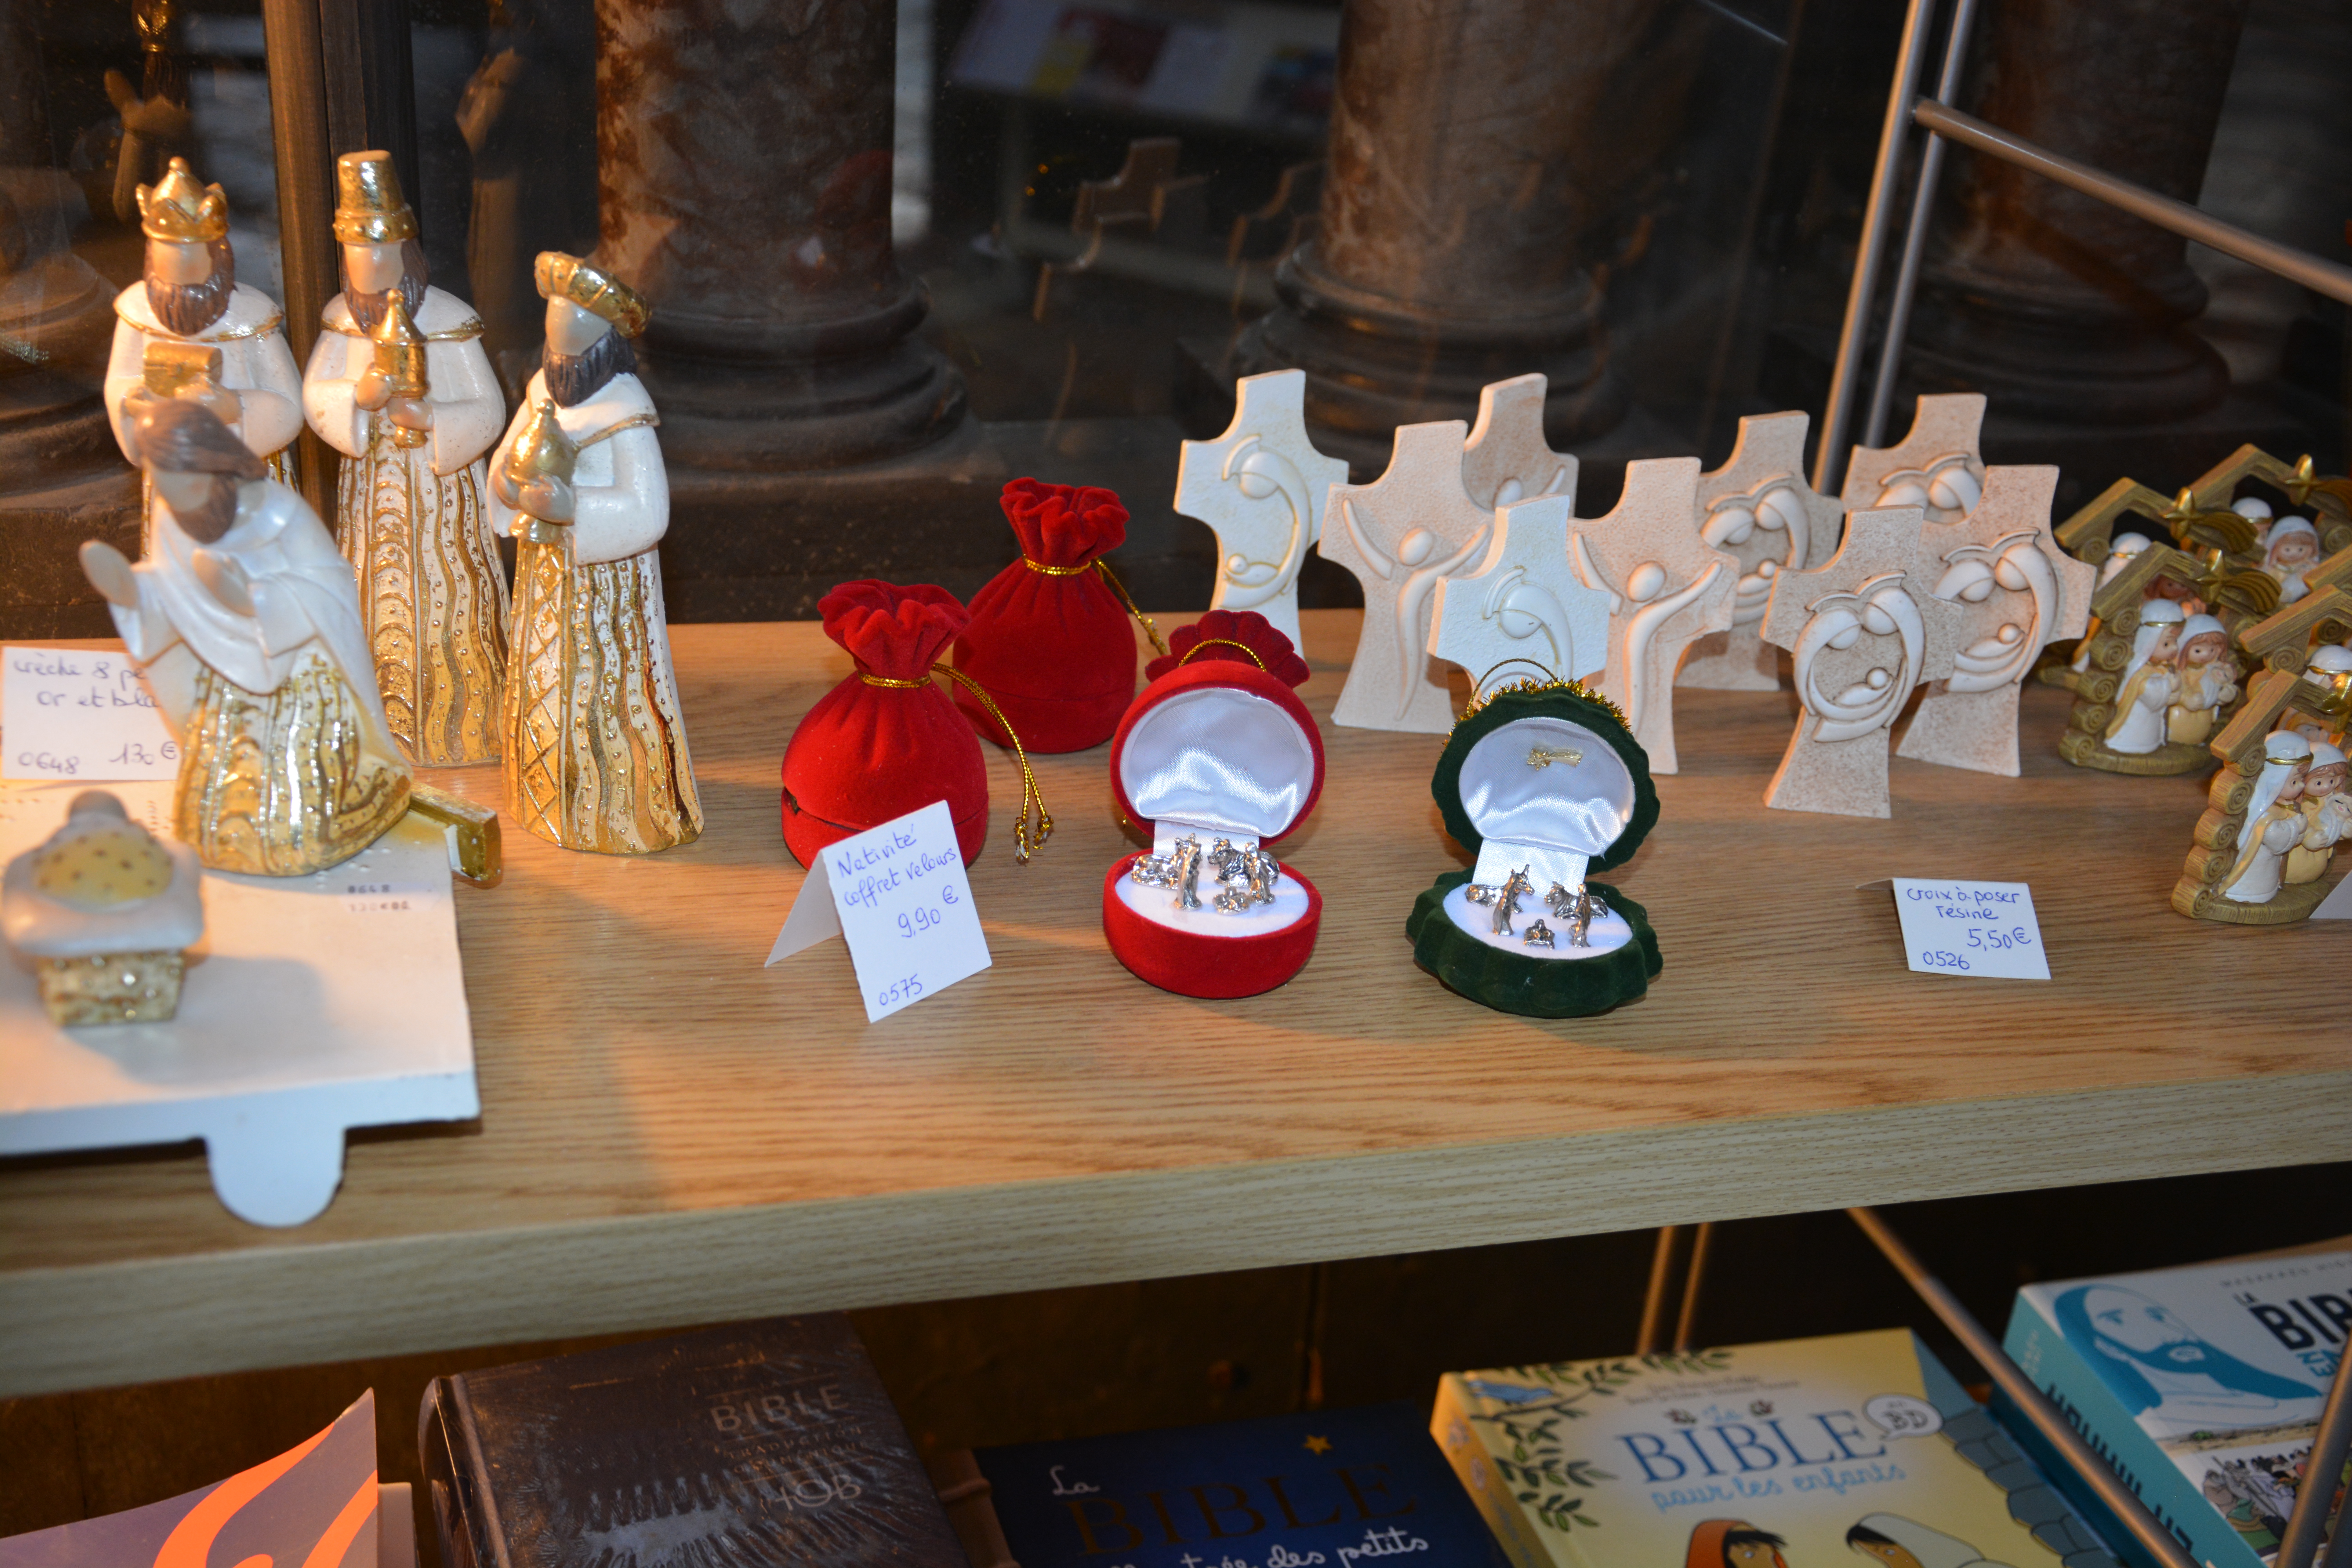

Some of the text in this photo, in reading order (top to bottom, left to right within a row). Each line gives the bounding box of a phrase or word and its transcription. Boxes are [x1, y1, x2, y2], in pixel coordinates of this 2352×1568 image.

[13, 652, 82, 676] crèche
[92, 661, 110, 679] 8
[77, 686, 106, 708] et
[18, 752, 80, 775] 0648
[837, 824, 917, 878] Nativité
[844, 867, 902, 908] coffret
[1955, 886, 1971, 900] à
[1974, 890, 2021, 906] poser
[1936, 903, 1999, 920] résine
[1967, 927, 2032, 952] 5,50€
[1922, 951, 1970, 971] 0526
[879, 973, 923, 1006] 0575
[710, 1383, 849, 1432] BIBLE
[1882, 1409, 1929, 1430] BD
[1613, 1409, 1887, 1484] BIBLE
[1049, 1464, 1101, 1497] La
[1650, 1461, 1907, 1513] pour les enfants
[1058, 1463, 1418, 1557] BIBLE
[1267, 1544, 1326, 1568] des
[1336, 1526, 1430, 1568] petits
